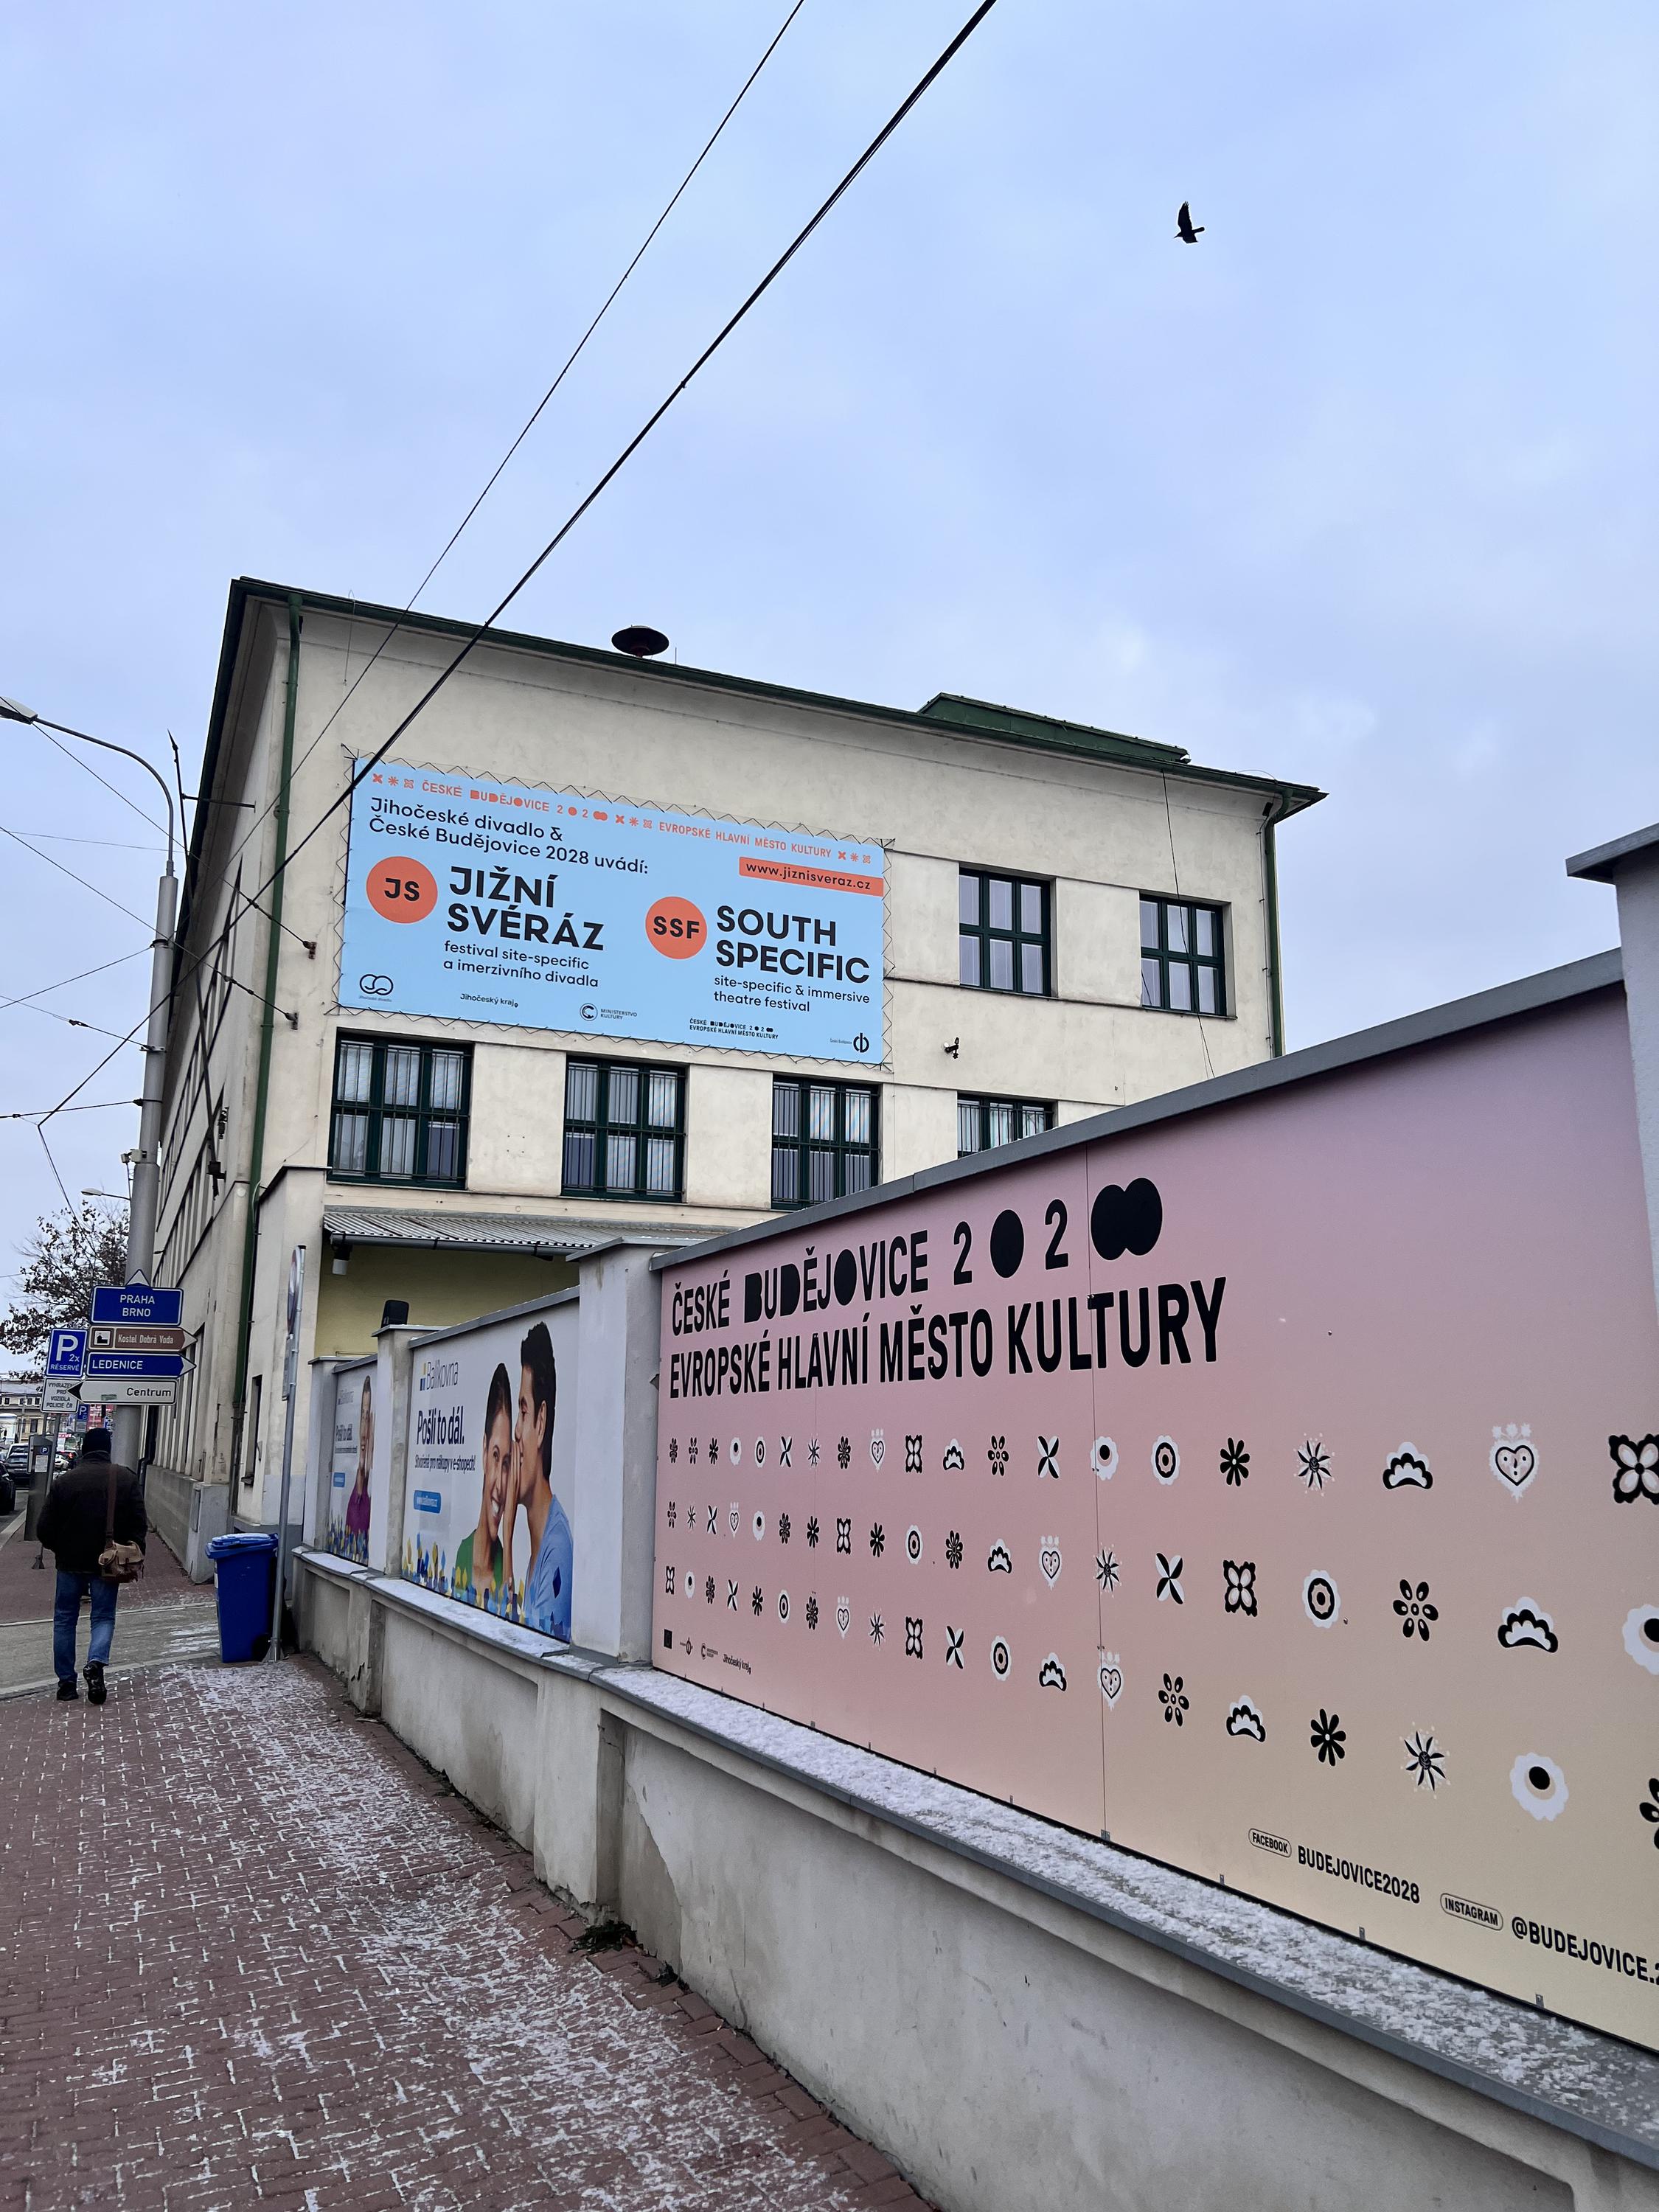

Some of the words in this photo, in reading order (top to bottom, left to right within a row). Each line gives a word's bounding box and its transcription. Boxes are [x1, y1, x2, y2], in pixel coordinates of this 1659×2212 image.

[422, 779, 462, 797] ČESKÉ
[470, 790, 549, 812] BUDĚJOVICE
[370, 797, 469, 826] Jihočeské
[474, 815, 544, 838] divadlo
[550, 827, 563, 841] &
[369, 818, 430, 839] České
[437, 828, 540, 857] Budějovice
[546, 845, 589, 865] 2028
[594, 855, 648, 874] uvádí:
[659, 821, 711, 838] EVROPSKÉ
[716, 831, 751, 845] HLAVNÍ
[755, 836, 787, 850] MĚSTO
[791, 843, 832, 858] KULTURY
[384, 877, 420, 902] JS
[449, 865, 558, 908] JIŽNÍ
[746, 863, 871, 890] www.jiznisveraz.cz
[447, 903, 604, 950] SVÉRÁZ
[653, 916, 700, 939] SSF
[717, 905, 836, 947] SOUTH
[445, 940, 498, 959] festival
[501, 949, 589, 970] site-specific
[716, 939, 869, 984] SPECIFIC
[443, 960, 453, 969] a
[457, 961, 541, 981] imerzivního
[545, 971, 599, 987] divadla
[460, 993, 498, 1005] Jihočeský
[714, 975, 792, 995] site-specific
[796, 984, 804, 995] &
[808, 987, 870, 1004] immersive
[714, 991, 762, 1006] theatre
[765, 996, 810, 1012] festival
[600, 1008, 637, 1017] MINISTERSTVO
[689, 1025, 717, 1033] EVROPSKÉ
[718, 1027, 737, 1035] HLAVNÍ
[672, 1270, 731, 1337] ČESKÉ
[744, 1229, 928, 1324] BUDĚJOVICE
[119, 1294, 155, 1304] PRAHA
[122, 1308, 151, 1317] BRNO
[56, 1335, 78, 1361] P
[118, 1334, 137, 1343] Kostel
[139, 1335, 157, 1343] Dobrá
[159, 1335, 174, 1344] Voda
[669, 1329, 770, 1399] EVROPSKÉ
[777, 1312, 869, 1390] HLAVNÍ
[880, 1304, 993, 1383] MĚSTO
[1007, 1276, 1227, 1374] KULTURY
[69, 1354, 80, 1362] 2x
[92, 1360, 143, 1369] LEDENICE
[127, 1387, 171, 1397] Centrum
[417, 1408, 437, 1445] Pošli
[437, 1410, 446, 1445] to
[448, 1405, 465, 1444] dál.
[1252, 1832, 1288, 1854] FACEBOOK
[1298, 1845, 1420, 1904] BUDEJOVICE2028
[1444, 1897, 1498, 1927] INSTAGRAM
